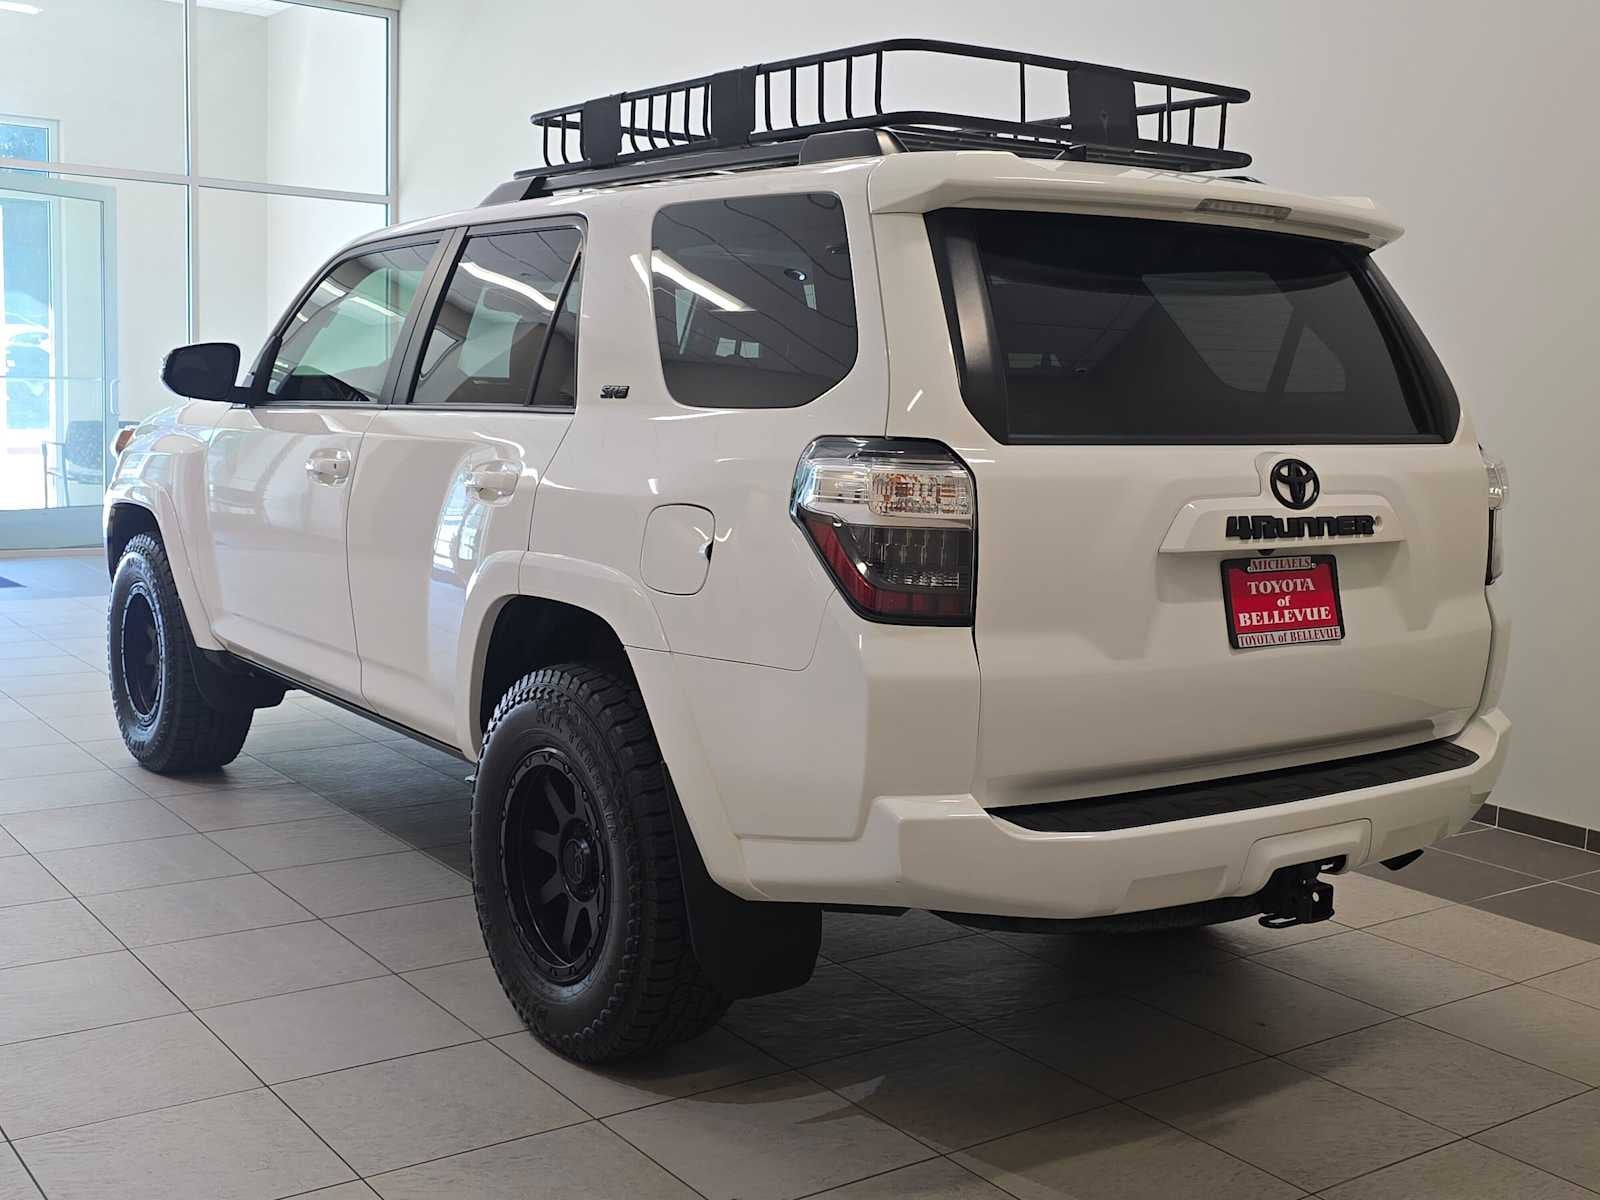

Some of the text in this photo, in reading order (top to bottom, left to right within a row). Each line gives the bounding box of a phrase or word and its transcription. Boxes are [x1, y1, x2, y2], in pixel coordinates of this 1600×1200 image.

[1251, 557, 1311, 570] MICHAELS
[1247, 578, 1316, 595] TOYOTA
[1277, 595, 1291, 607] of
[1238, 606, 1332, 627] BELLEVUE
[1238, 627, 1340, 647] TOYOTA of BELLEVUE
